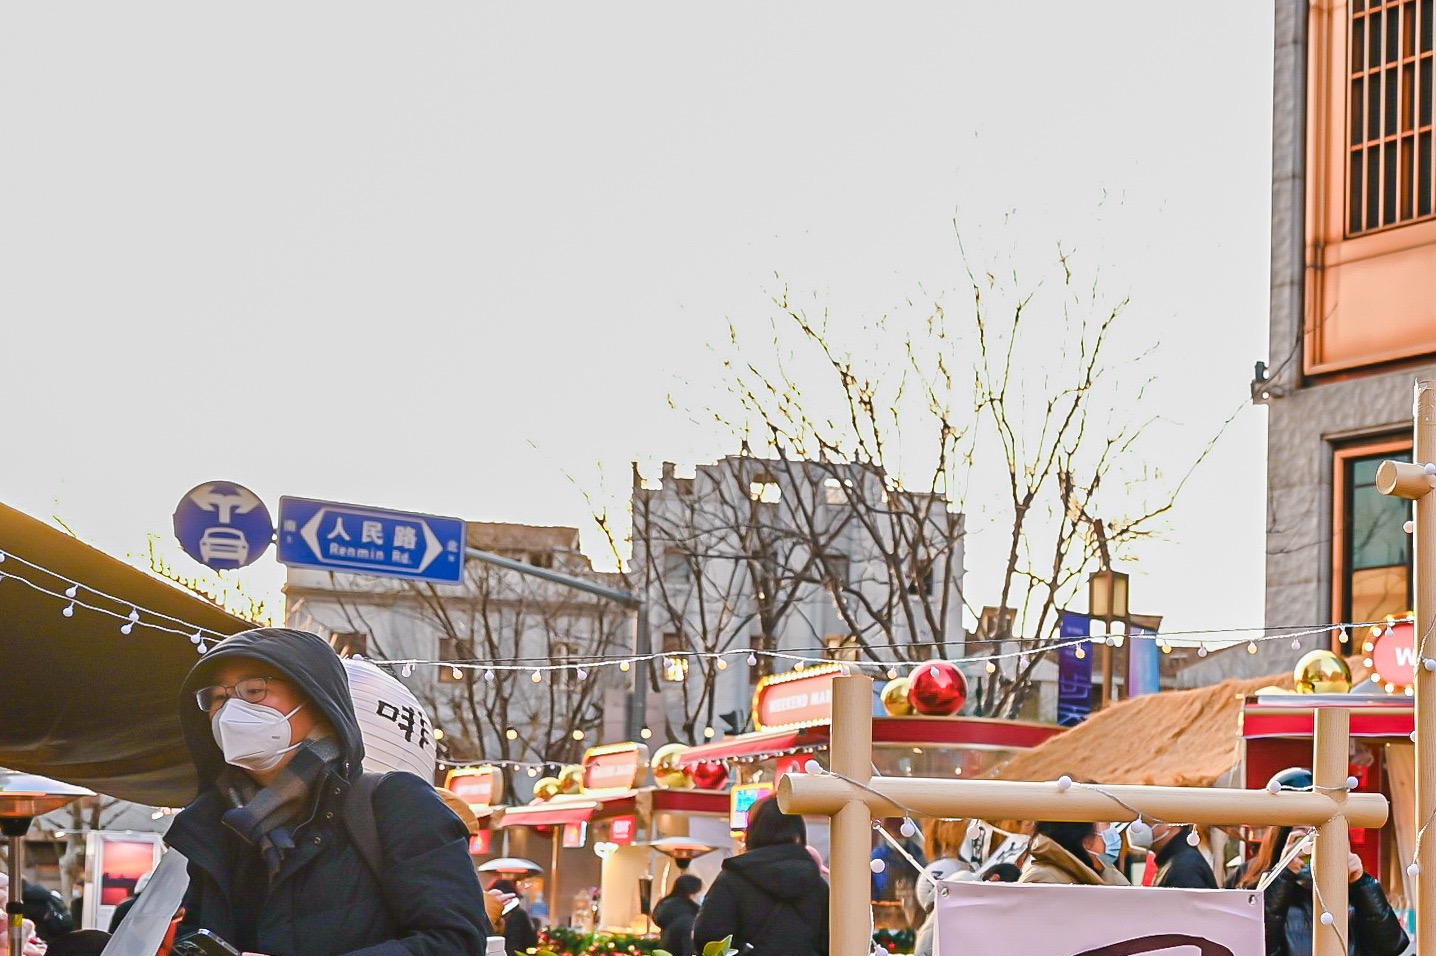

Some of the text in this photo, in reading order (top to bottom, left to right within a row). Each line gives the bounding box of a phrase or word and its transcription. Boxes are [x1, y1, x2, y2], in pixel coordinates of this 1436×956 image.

[327, 516, 417, 549] 人民路
[329, 542, 385, 561] Renmin
